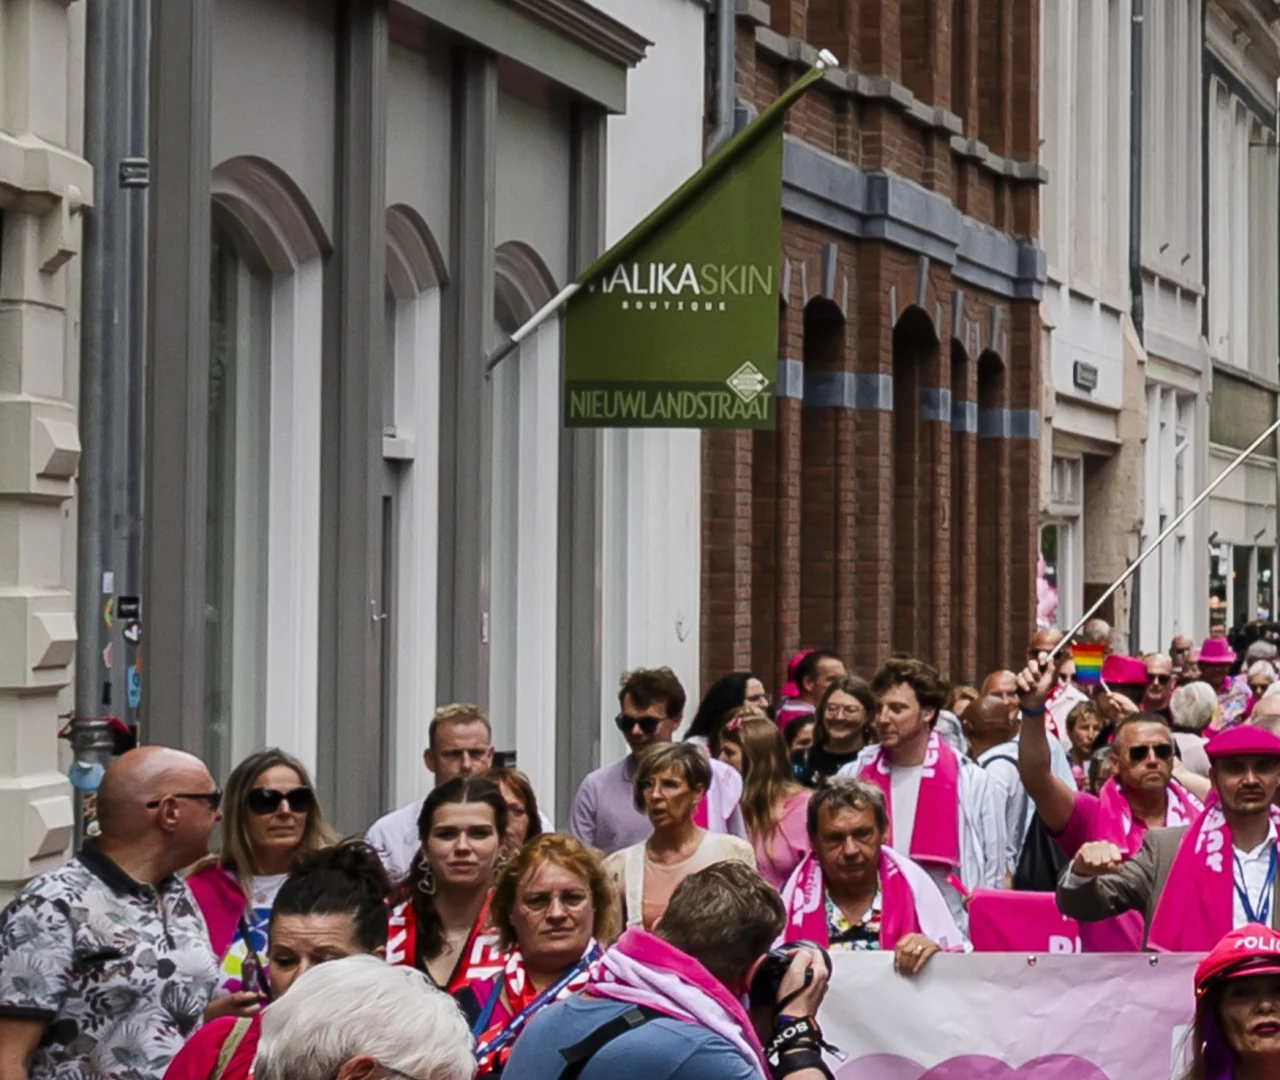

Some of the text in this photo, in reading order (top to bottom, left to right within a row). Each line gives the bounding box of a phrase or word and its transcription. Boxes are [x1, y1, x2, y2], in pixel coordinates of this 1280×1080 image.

[588, 262, 773, 295] ALIKASKIN
[621, 301, 726, 312] BOUTIQUE
[570, 390, 772, 420] NIEUWLANDSTRAAT
